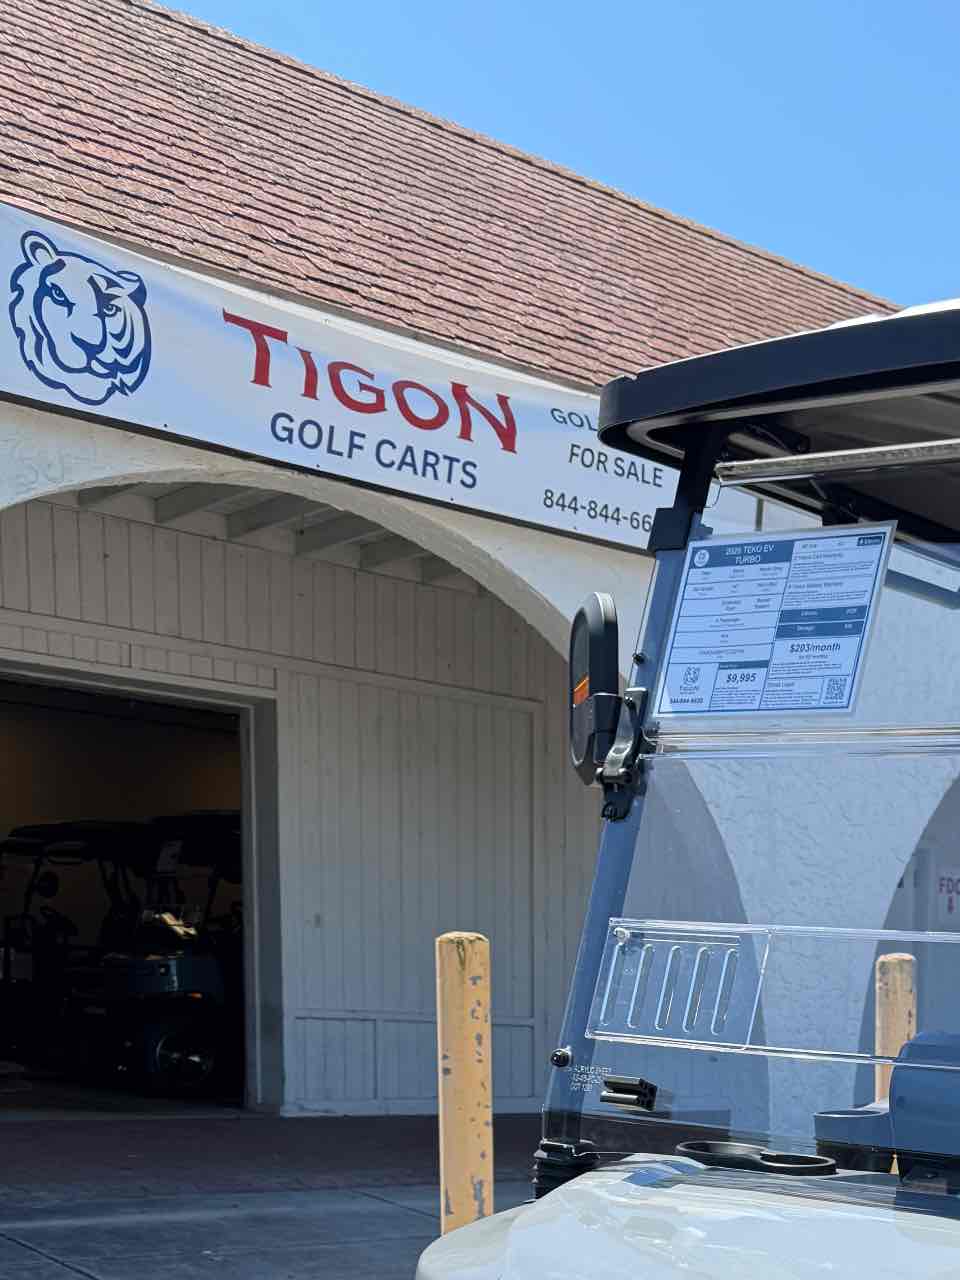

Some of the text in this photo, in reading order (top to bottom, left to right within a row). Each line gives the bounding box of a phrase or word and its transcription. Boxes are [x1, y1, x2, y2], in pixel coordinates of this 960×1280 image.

[222, 308, 518, 454] TIGON
[551, 408, 598, 432] GOL
[270, 412, 478, 489] GOLF CARTS
[568, 443, 664, 488] FOR SALE
[543, 488, 653, 533] 844-844-66
[726, 672, 758, 685] $9,995
